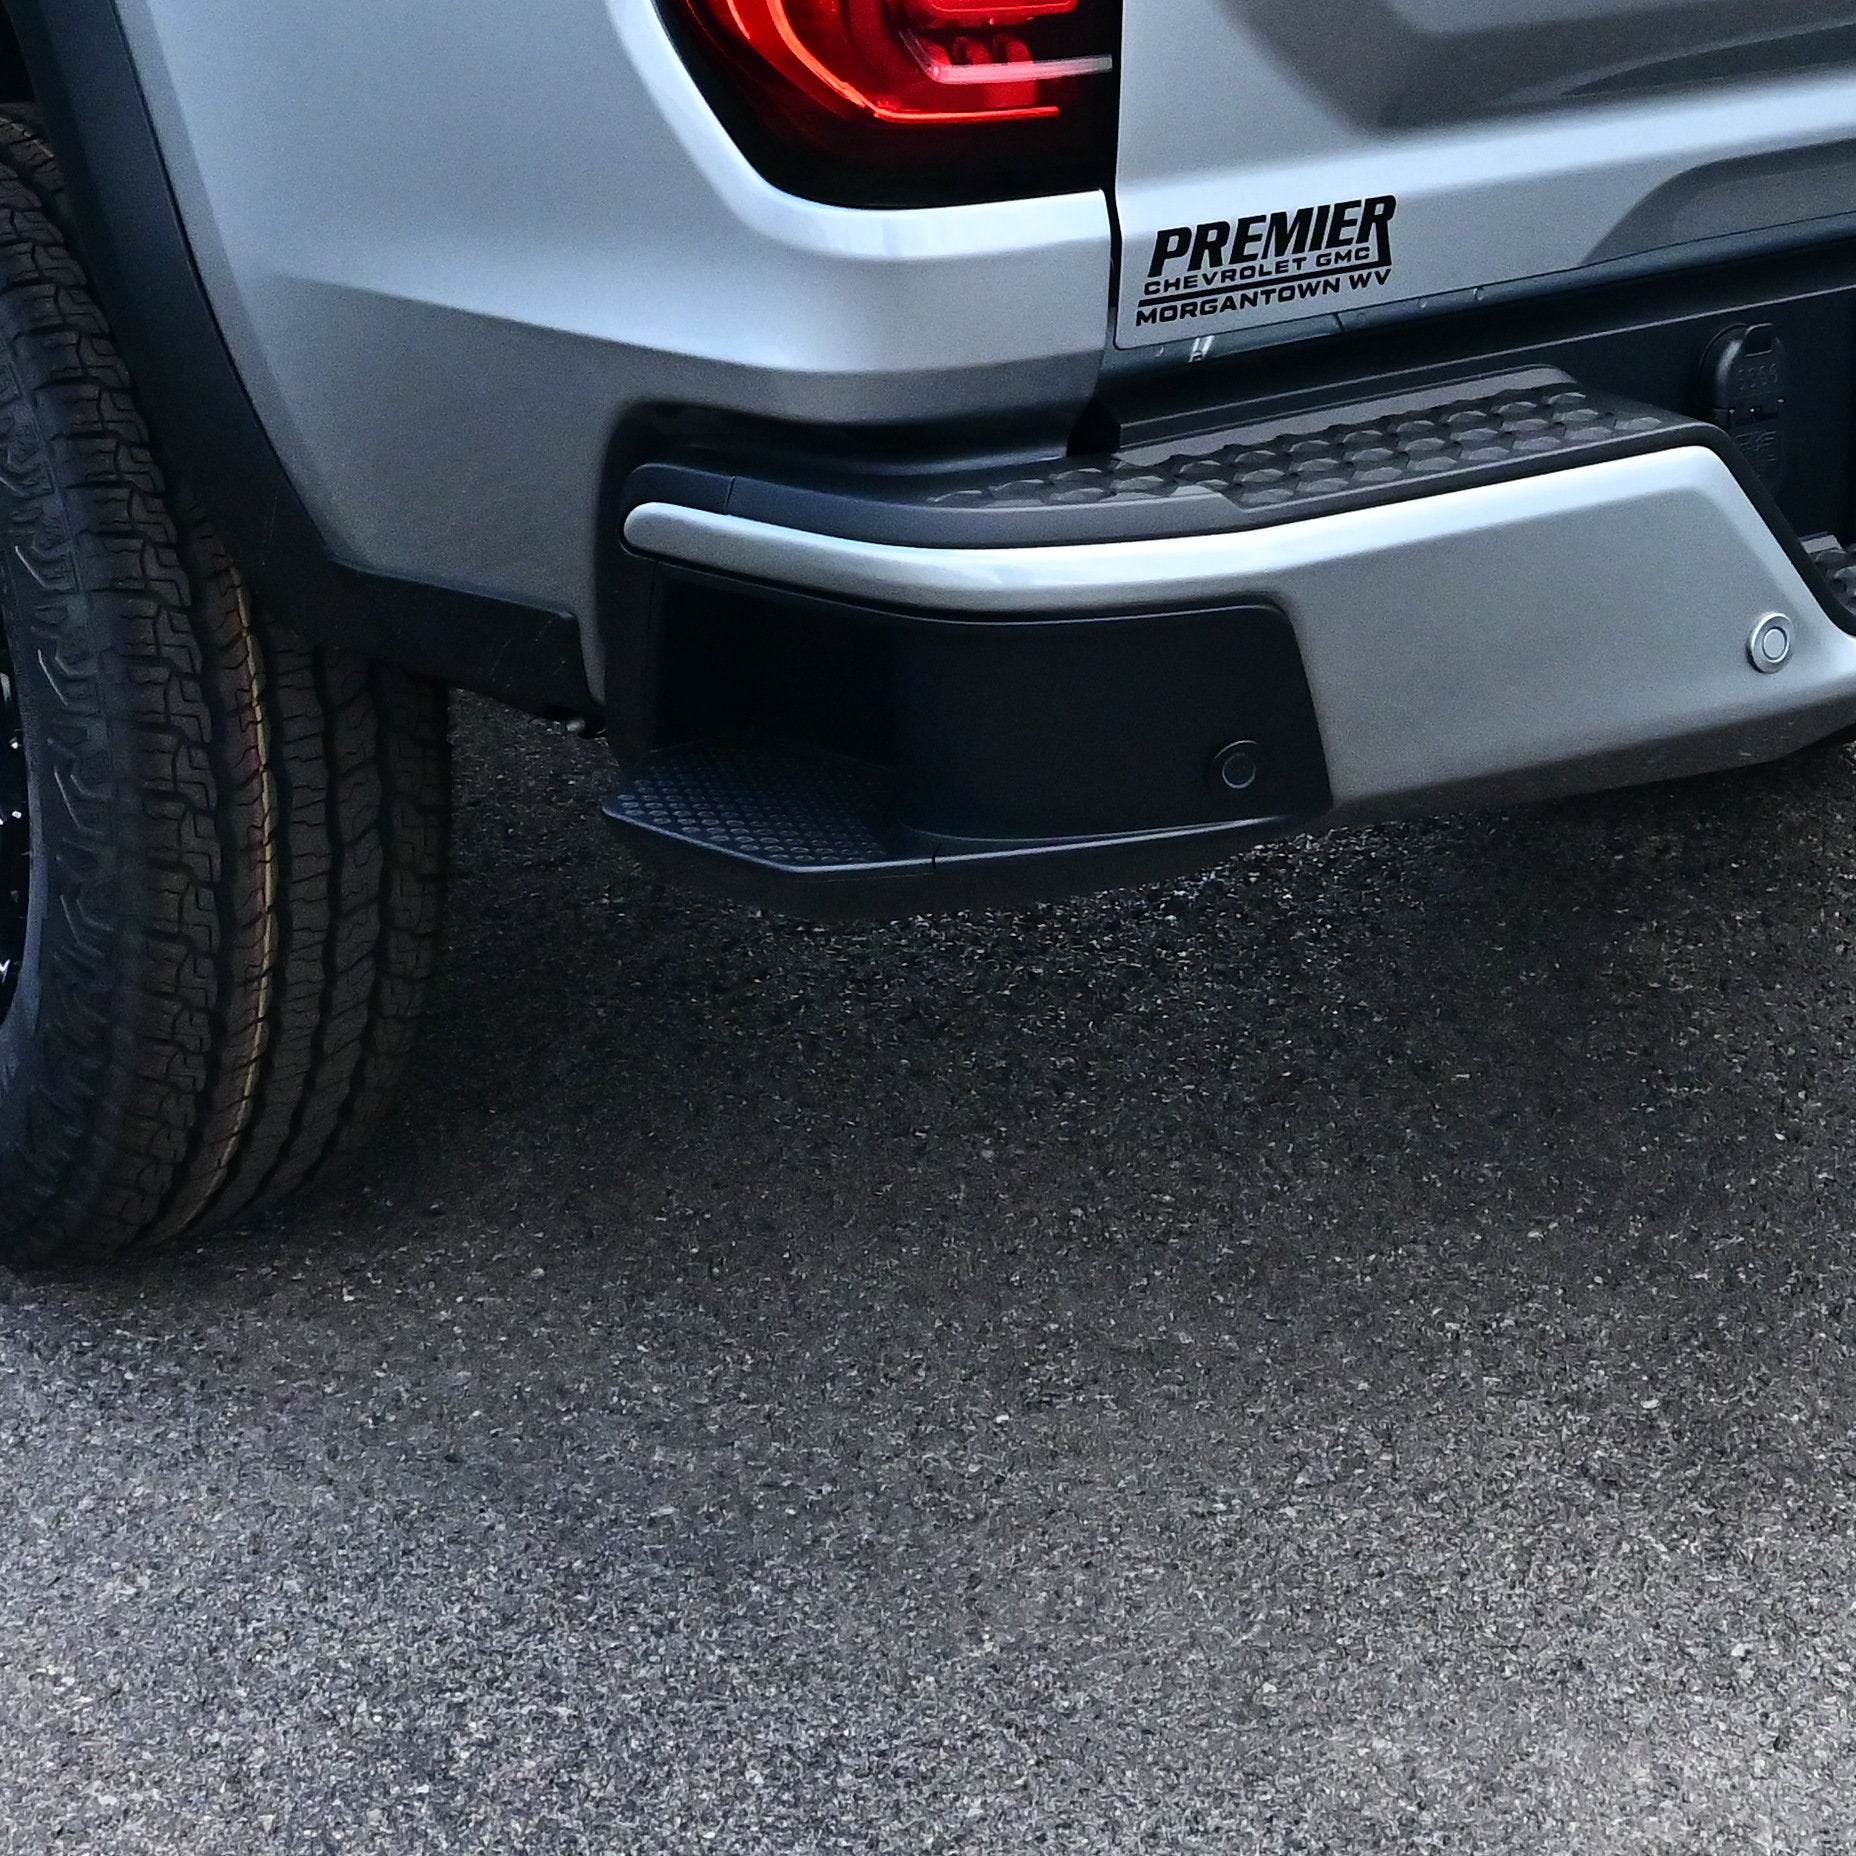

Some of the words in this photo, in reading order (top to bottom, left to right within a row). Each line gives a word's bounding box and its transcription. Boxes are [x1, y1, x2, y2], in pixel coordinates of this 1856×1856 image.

[1146, 193, 1397, 278] PREMIER
[1135, 277, 1342, 327] MORGANTOWN
[1348, 267, 1392, 290] WV
[1143, 255, 1308, 296] CHEVROLET
[1315, 245, 1371, 271] GMC
